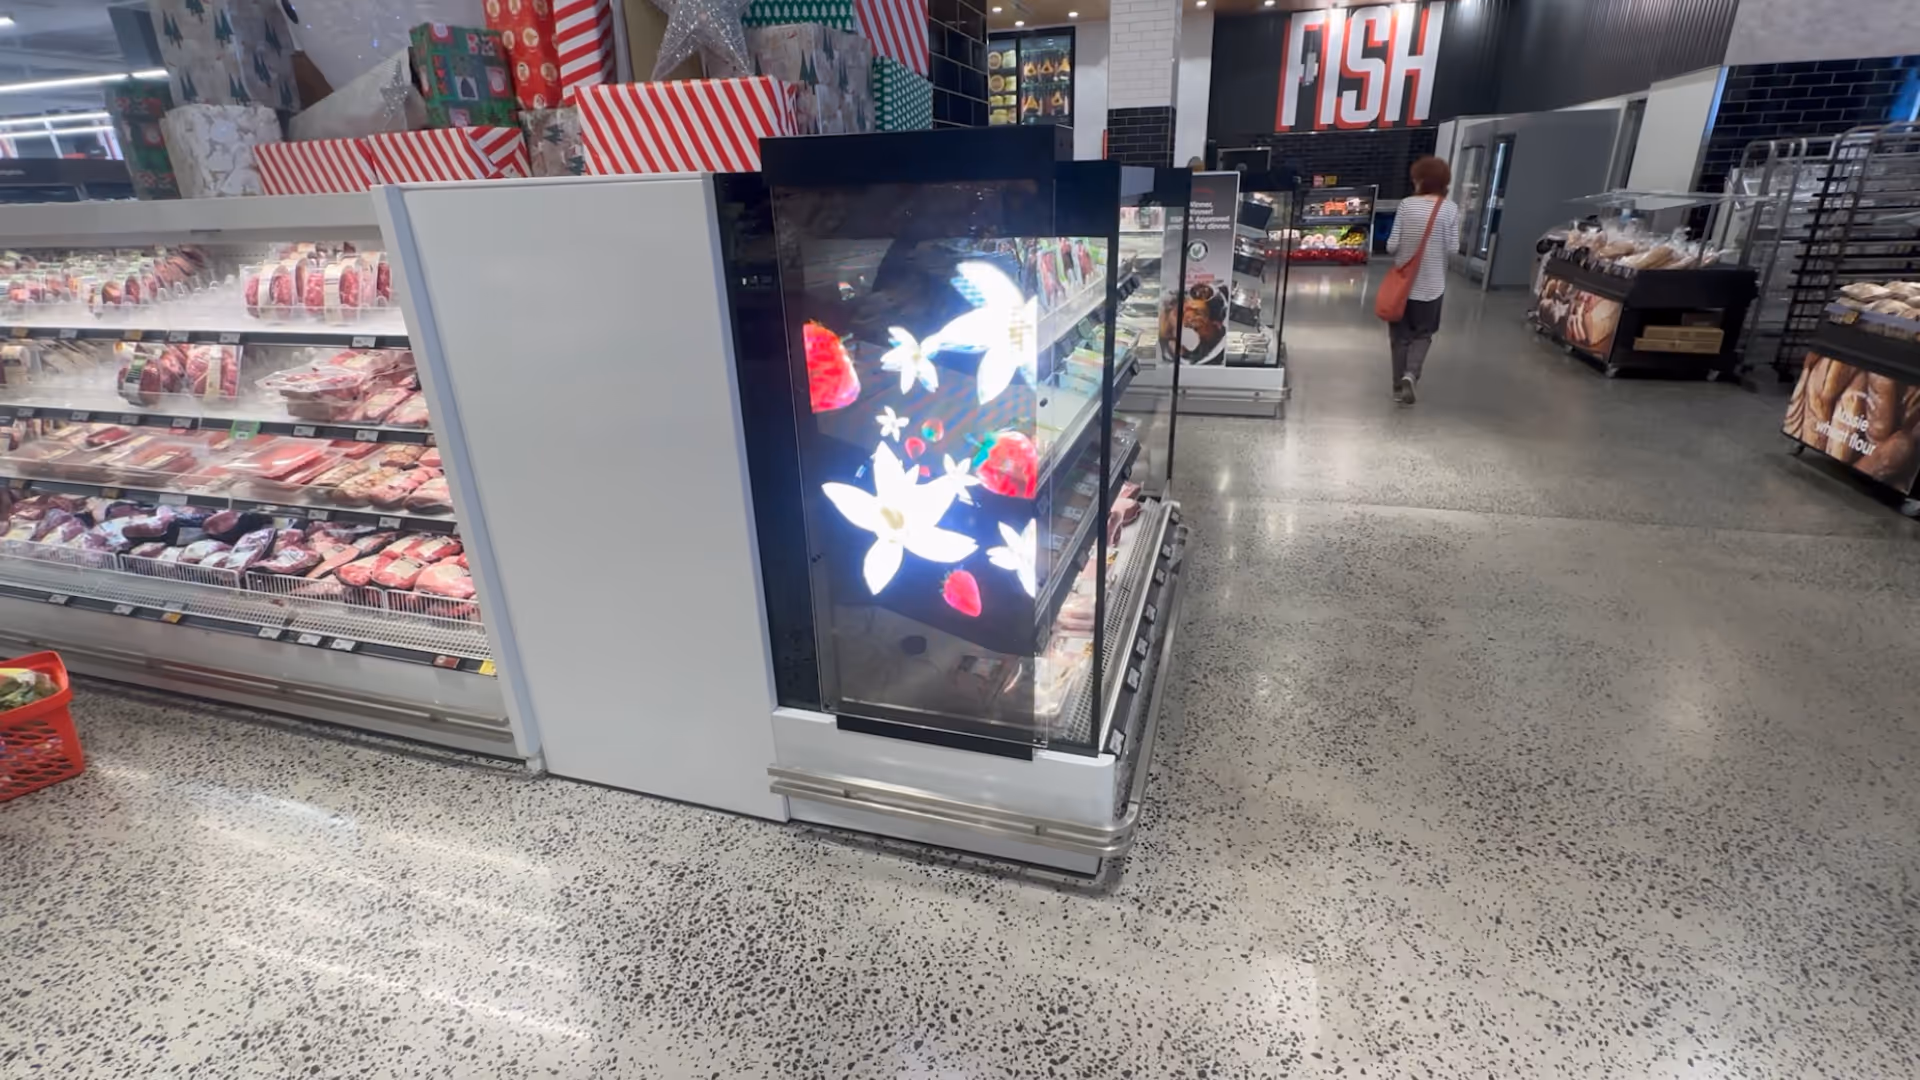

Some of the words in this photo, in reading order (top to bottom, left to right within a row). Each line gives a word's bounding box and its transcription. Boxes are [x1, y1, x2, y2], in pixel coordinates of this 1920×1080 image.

[1276, 2, 1445, 132] FISH
[1195, 215, 1230, 224] Approved
[1848, 432, 1877, 456] flour
